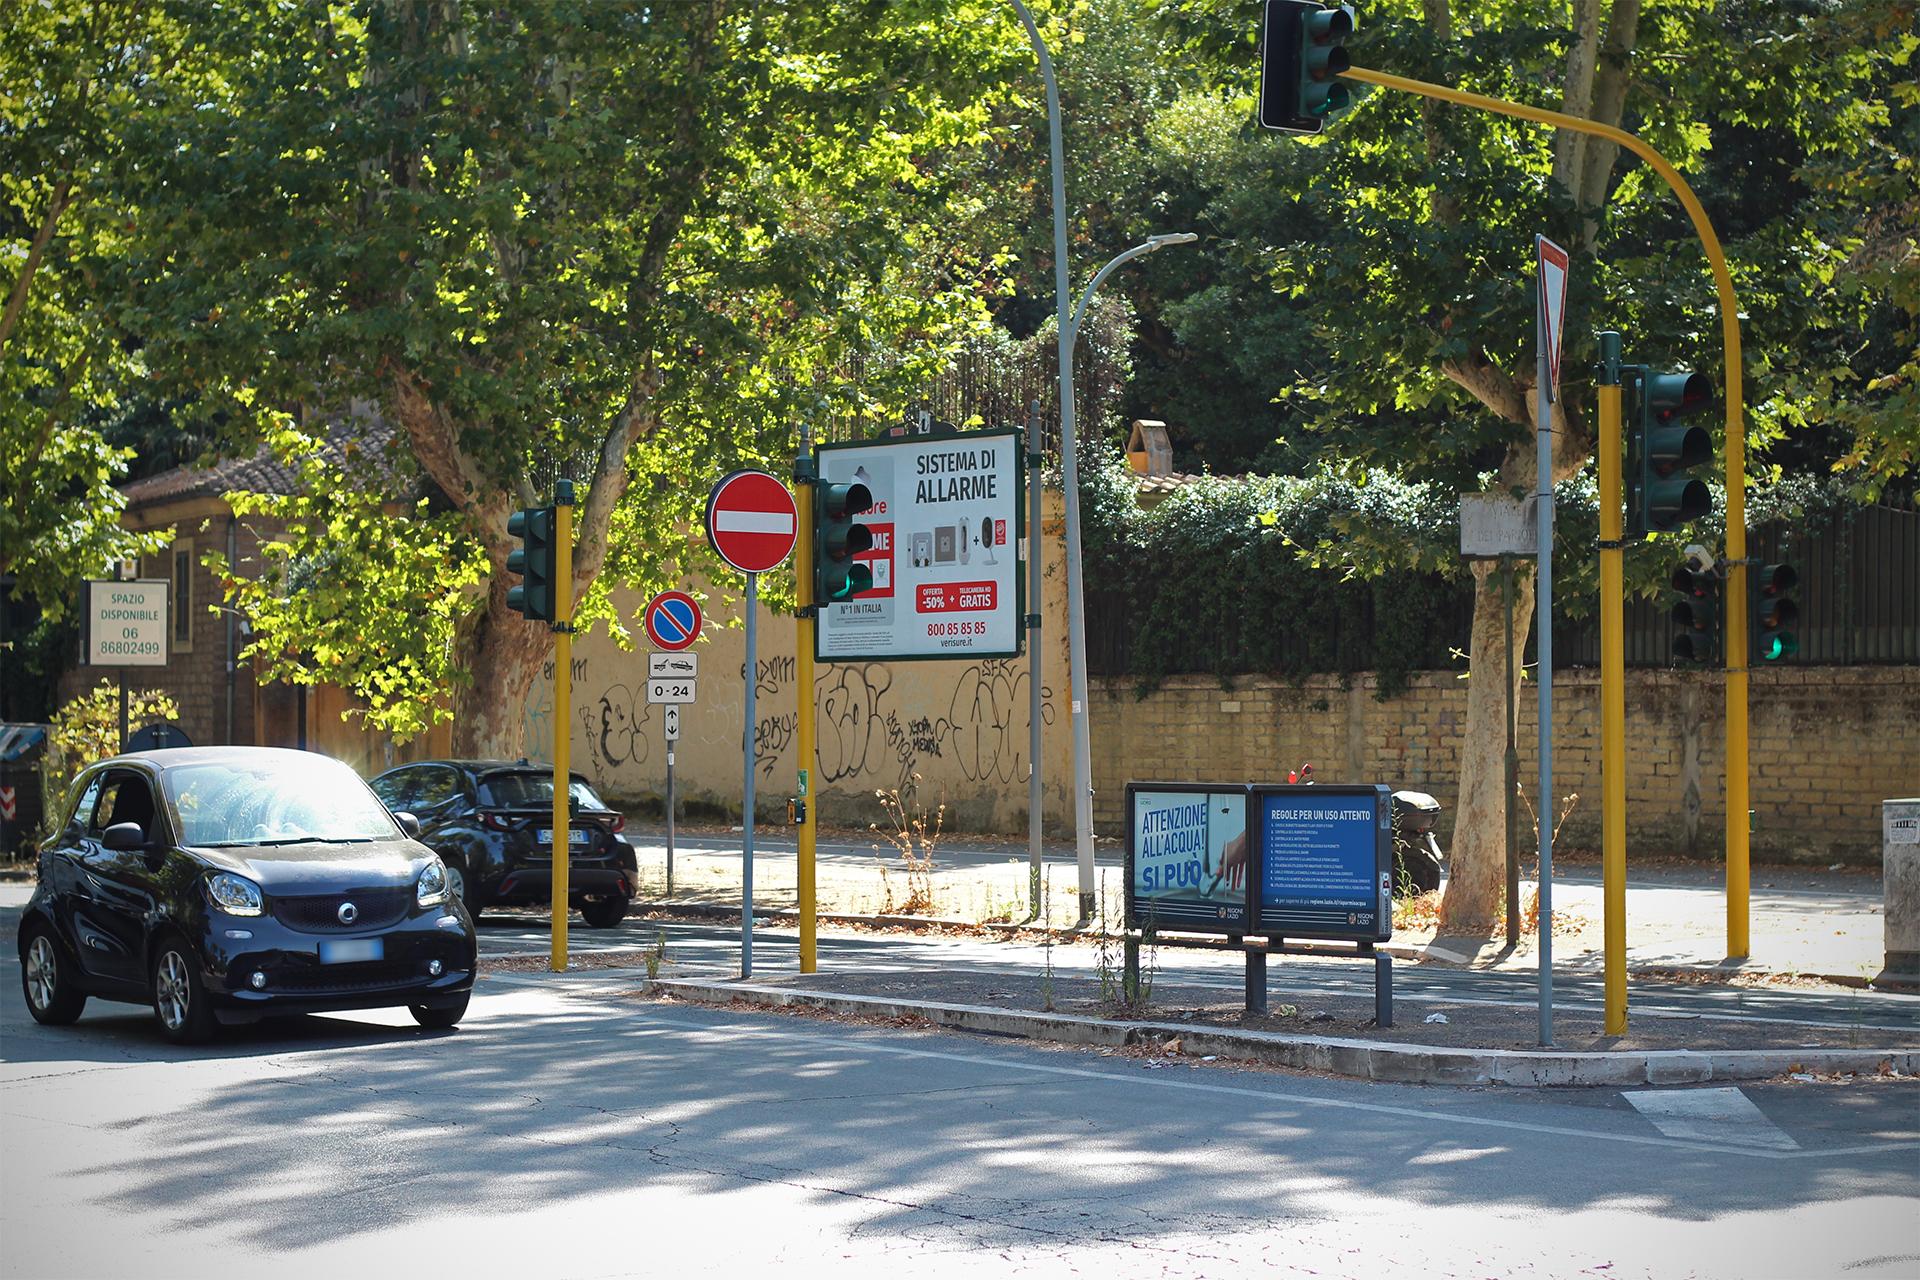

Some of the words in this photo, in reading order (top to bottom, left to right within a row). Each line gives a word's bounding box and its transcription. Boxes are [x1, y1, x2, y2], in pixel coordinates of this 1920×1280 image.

[916, 451, 977, 475] SISTEMA
[981, 449, 996, 469] DI
[915, 474, 997, 504] ALLARME
[111, 593, 145, 604] SPAZIO
[922, 587, 944, 596] OFFERTA
[862, 603, 882, 614] ITALIA
[922, 596, 945, 609] -50%
[959, 594, 992, 608] GRATIS
[101, 609, 159, 621] DISPONIBILE
[122, 627, 139, 639] 06
[927, 623, 945, 636] 800
[947, 622, 959, 635] 85
[961, 622, 972, 635] 85
[974, 621, 986, 634] 85
[100, 641, 160, 655] 86802499
[940, 636, 973, 648] verisure.it
[1142, 803, 1207, 834] ATTENZIONE
[1271, 810, 1298, 820] REGOLE
[1299, 810, 1313, 820] PER
[1313, 811, 1323, 820] UN
[1324, 811, 1338, 820] USO
[1339, 811, 1371, 821] ATTENTO
[1142, 828, 1205, 859] ALL'ACQUA!
[1142, 866, 1160, 892] SI
[1164, 852, 1202, 890] PUÒ
